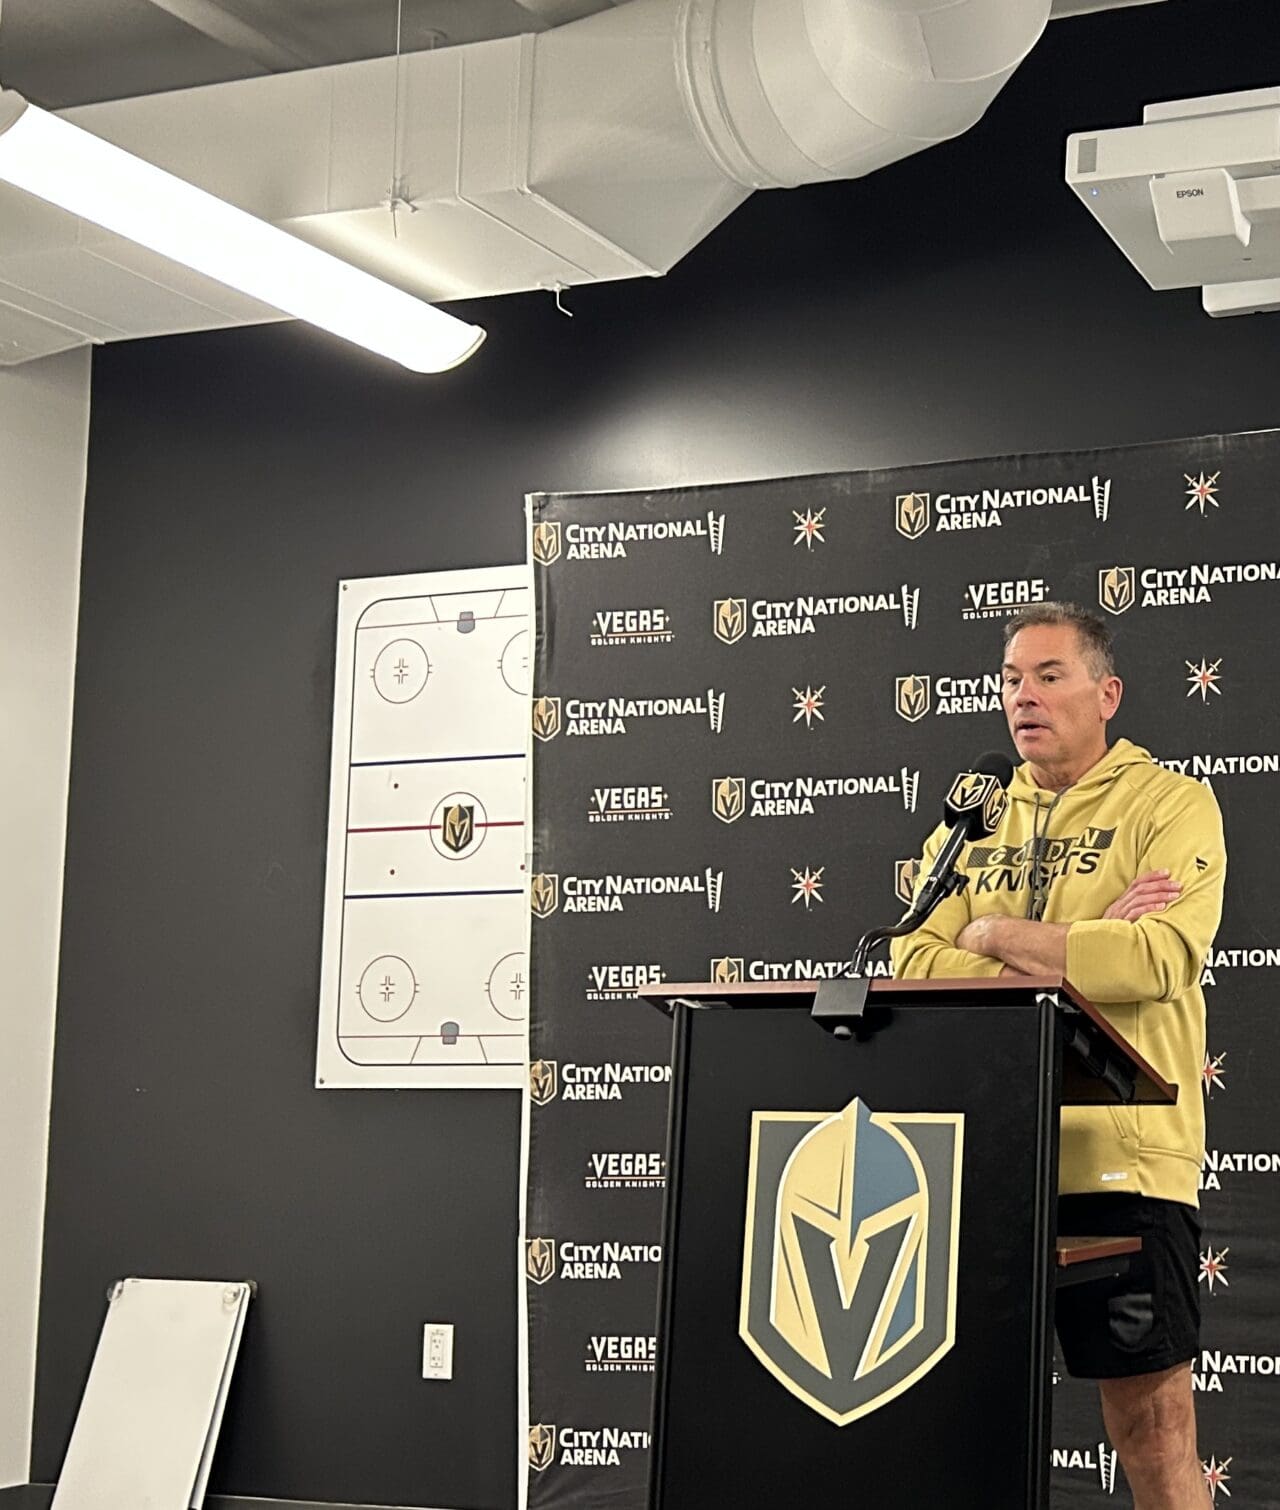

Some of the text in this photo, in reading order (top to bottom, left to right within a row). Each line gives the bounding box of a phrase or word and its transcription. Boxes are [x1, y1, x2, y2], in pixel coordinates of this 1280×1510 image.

[1176, 188, 1204, 198] EPSON
[935, 485, 1092, 514] CITY NATIONAL
[935, 509, 1002, 532] ARENA
[565, 519, 708, 544] CITY NATIONAL
[566, 540, 628, 561] ARENA
[1140, 568, 1188, 589] CITY
[968, 578, 1045, 611] VEGAS
[1141, 585, 1212, 608] ARENA
[751, 593, 901, 620] CITY NATIONAL
[962, 609, 1002, 620] GOLDEN
[595, 608, 665, 637] VEGAS
[751, 616, 816, 638] ARENA
[590, 634, 672, 646] GOLDEN KNIGHTS
[935, 676, 981, 698] CITY
[565, 696, 708, 719] CITY NATIONAL
[935, 693, 1004, 716] ARENA
[565, 717, 627, 737] ARENA
[750, 775, 901, 800] CITY NATIONAL
[593, 786, 663, 814] VEGAS
[750, 797, 815, 817] ARENA
[588, 812, 670, 823] GOLDEN KNIGHTS
[562, 875, 706, 896] CITY NATIONAL
[562, 895, 624, 913] ARENA
[591, 964, 662, 992] VEGAS
[748, 960, 793, 981] CITY
[586, 992, 623, 1001] GOLDEN
[561, 1063, 603, 1084] CITY
[561, 1083, 623, 1101] ARENA
[591, 1153, 661, 1179] VEGAS
[585, 1180, 622, 1189] GOLDEN
[558, 1241, 662, 1263] CITY NATIO
[559, 1262, 622, 1280] ARENA
[590, 1336, 657, 1362] VEGAS
[585, 1363, 656, 1373] GOLDEN KNIGH
[558, 1427, 601, 1449] CITY
[559, 1448, 621, 1466] ARENA
